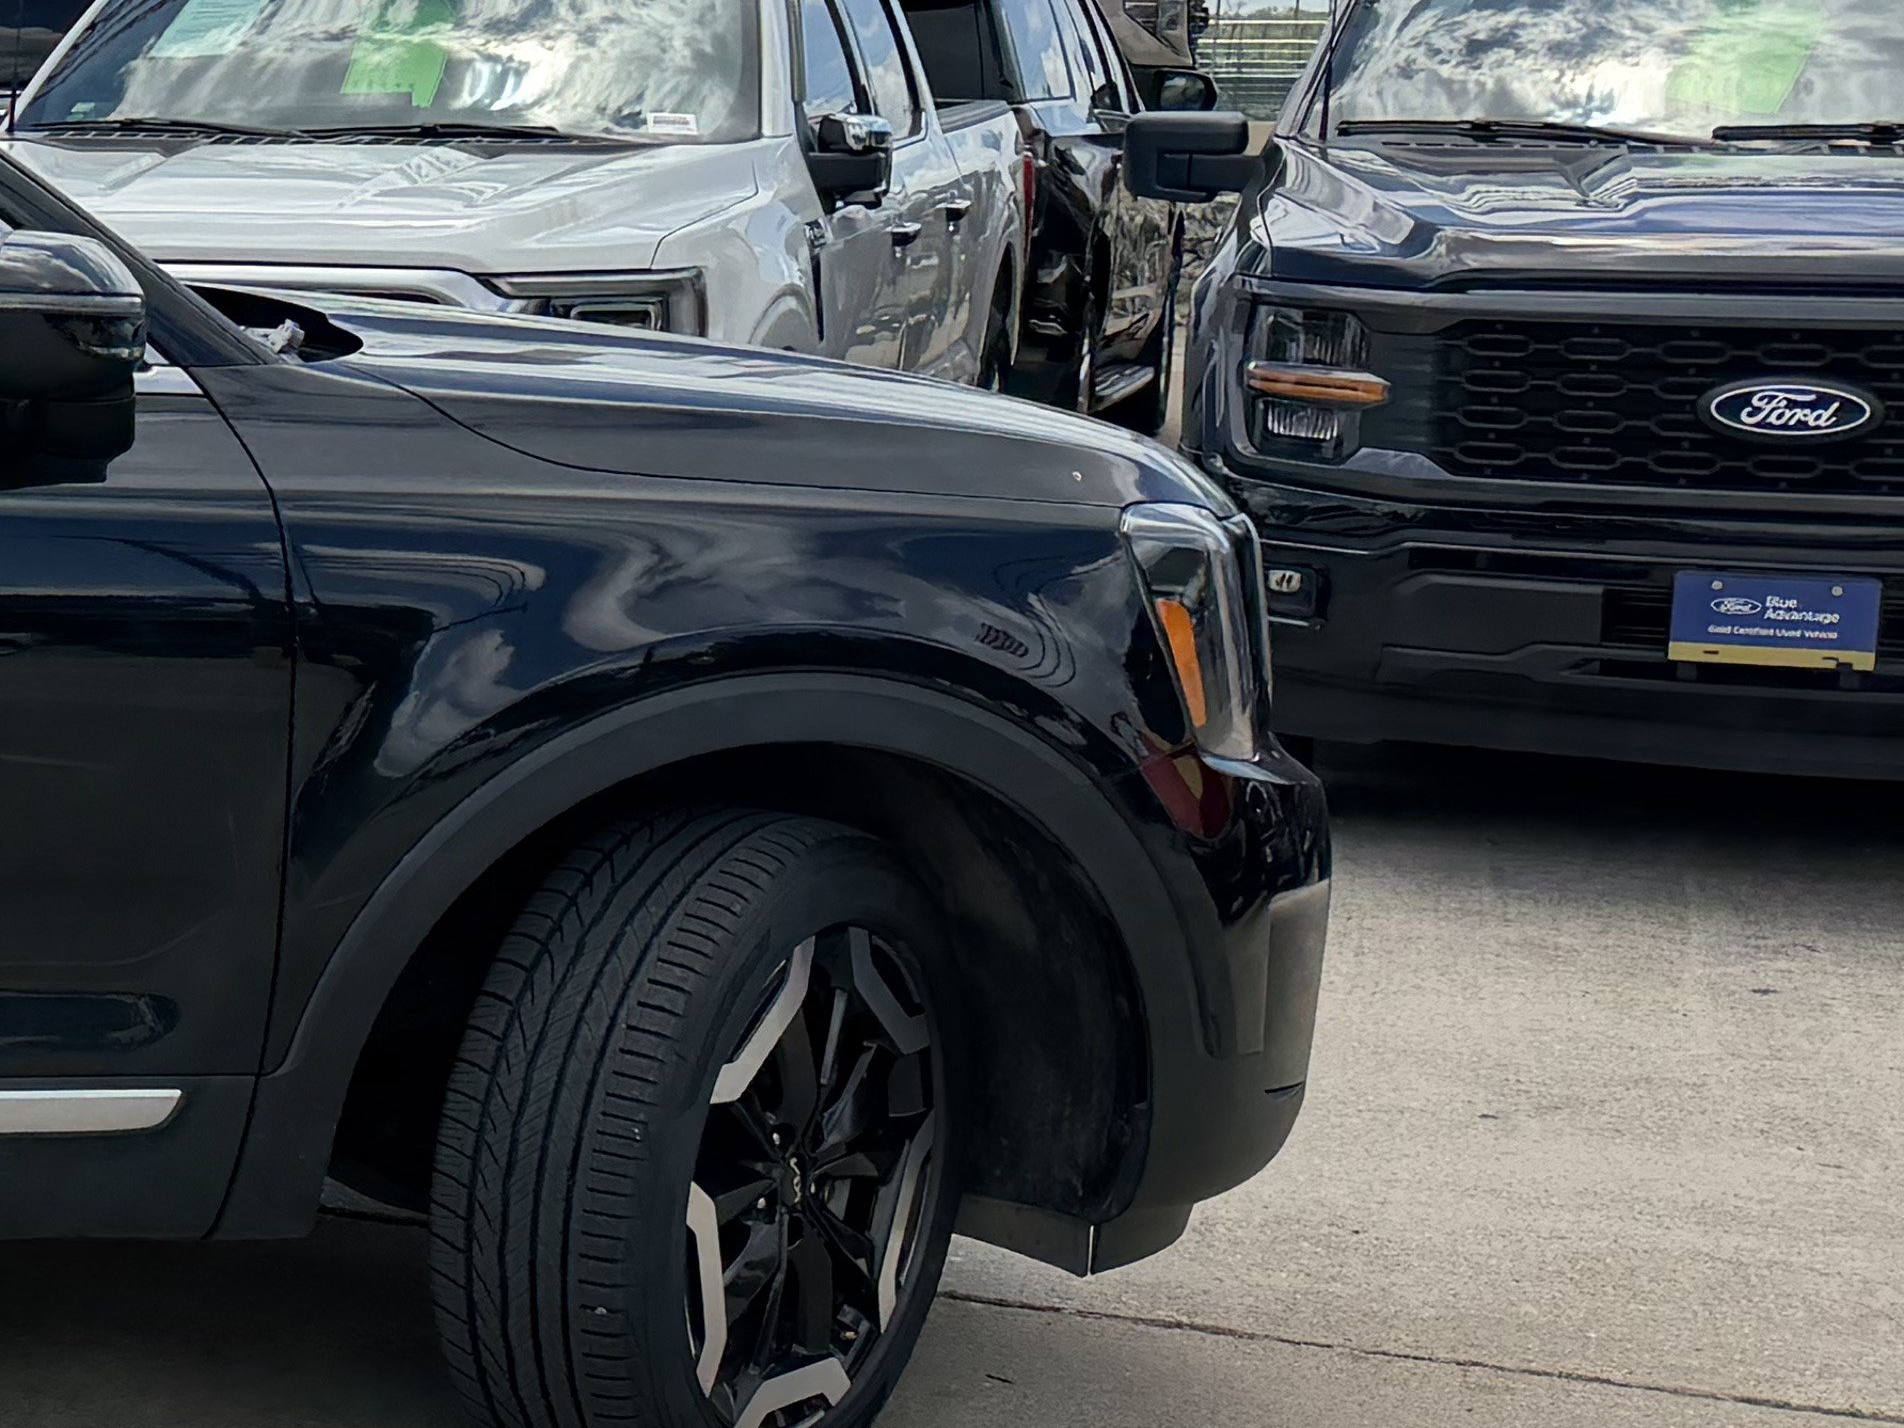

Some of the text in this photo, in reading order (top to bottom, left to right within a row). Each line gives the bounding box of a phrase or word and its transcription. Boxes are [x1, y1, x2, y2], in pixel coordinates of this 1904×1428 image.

[1740, 391, 1840, 427] Ford
[1765, 595, 1798, 609] Blue
[1763, 608, 1841, 625] Advantage
